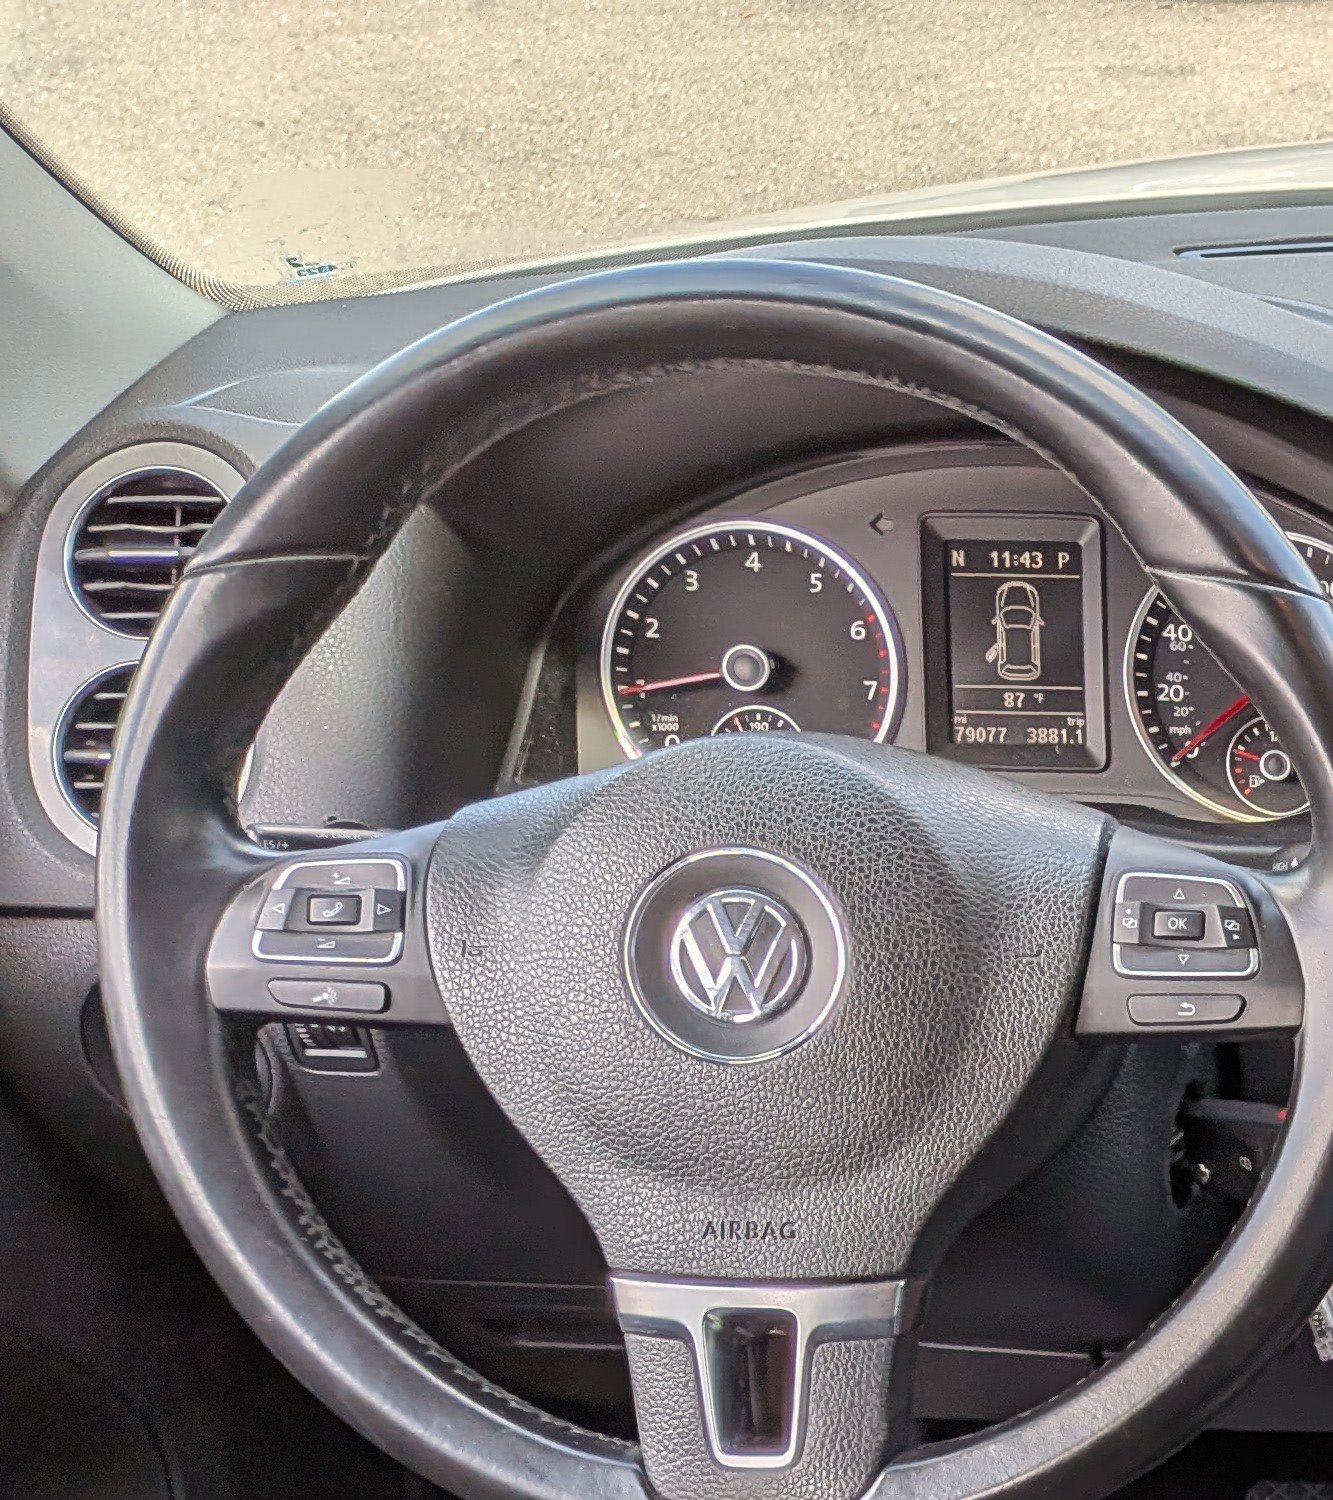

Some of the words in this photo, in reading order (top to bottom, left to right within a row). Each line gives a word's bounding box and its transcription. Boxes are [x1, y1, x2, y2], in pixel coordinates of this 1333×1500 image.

[745, 551, 762, 573] 4
[951, 550, 966, 567] N
[990, 550, 1043, 569] 11:43
[1058, 552, 1070, 568] P
[685, 570, 698, 591] 3
[809, 573, 823, 593] 5
[645, 618, 660, 638] 2
[850, 620, 866, 640] 6
[1161, 624, 1193, 642] 40
[1169, 640, 1187, 652] 60
[862, 680, 878, 700] 7
[1157, 684, 1184, 702] 20
[1003, 692, 1025, 708] 87
[651, 722, 680, 732] x1000
[1067, 716, 1085, 727] trip
[1169, 725, 1192, 736] mph
[955, 727, 1008, 743] 79077
[1026, 728, 1083, 745] 3881.1
[1167, 917, 1188, 930] OK
[701, 1220, 797, 1241] AIRBAG
